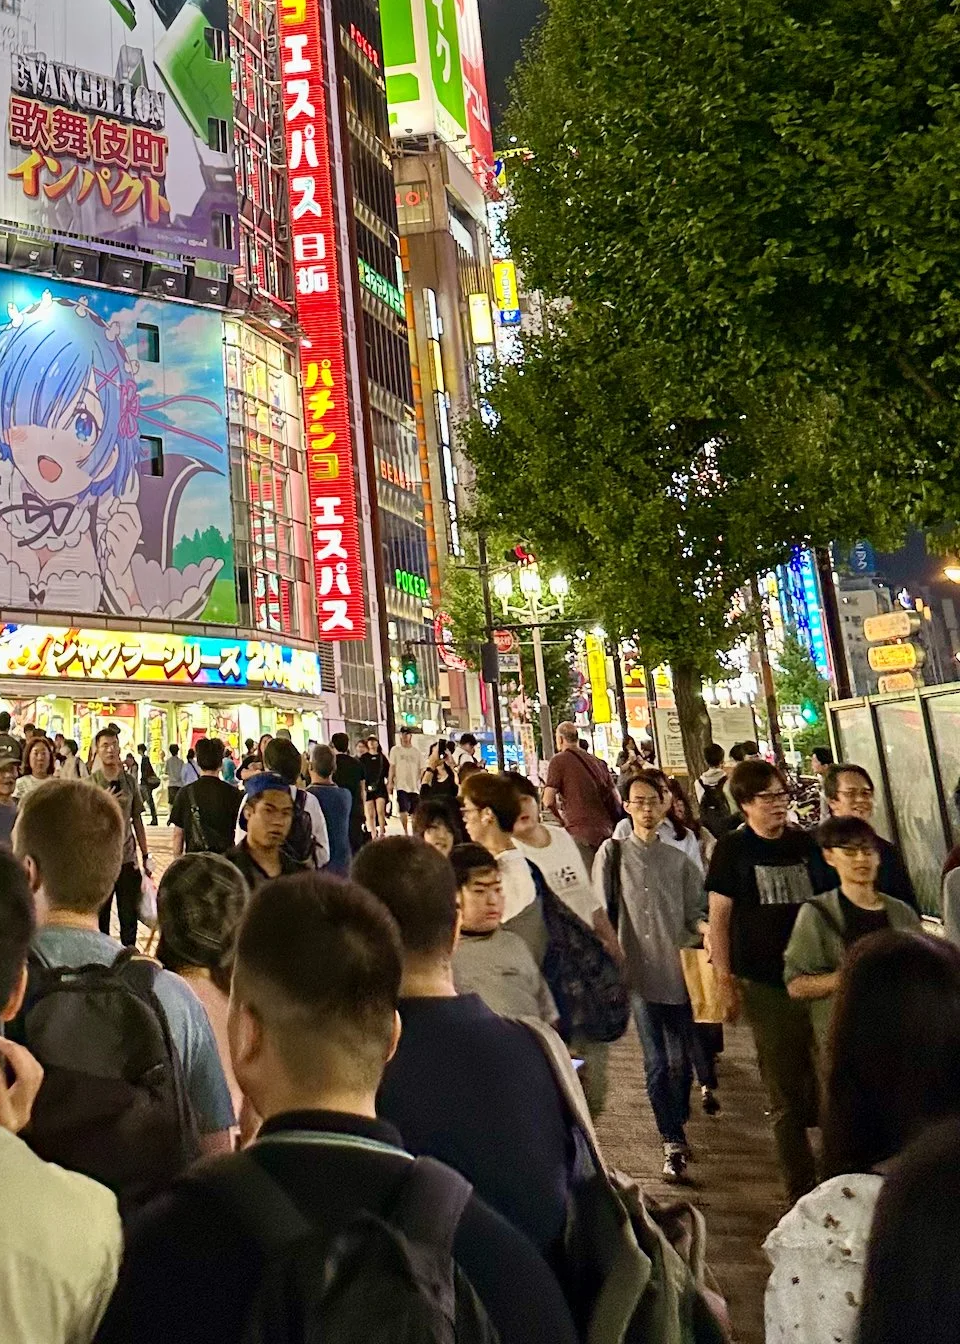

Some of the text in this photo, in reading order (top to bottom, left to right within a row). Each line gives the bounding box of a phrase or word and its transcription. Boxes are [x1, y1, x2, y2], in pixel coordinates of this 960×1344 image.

[13, 56, 165, 128] EVANGELION
[284, 34, 322, 220] エスパス
[9, 96, 168, 175] 歌舞伎町
[7, 149, 171, 223] インパクト
[305, 359, 354, 632] パチンコ エスパス
[395, 568, 427, 599] POKER
